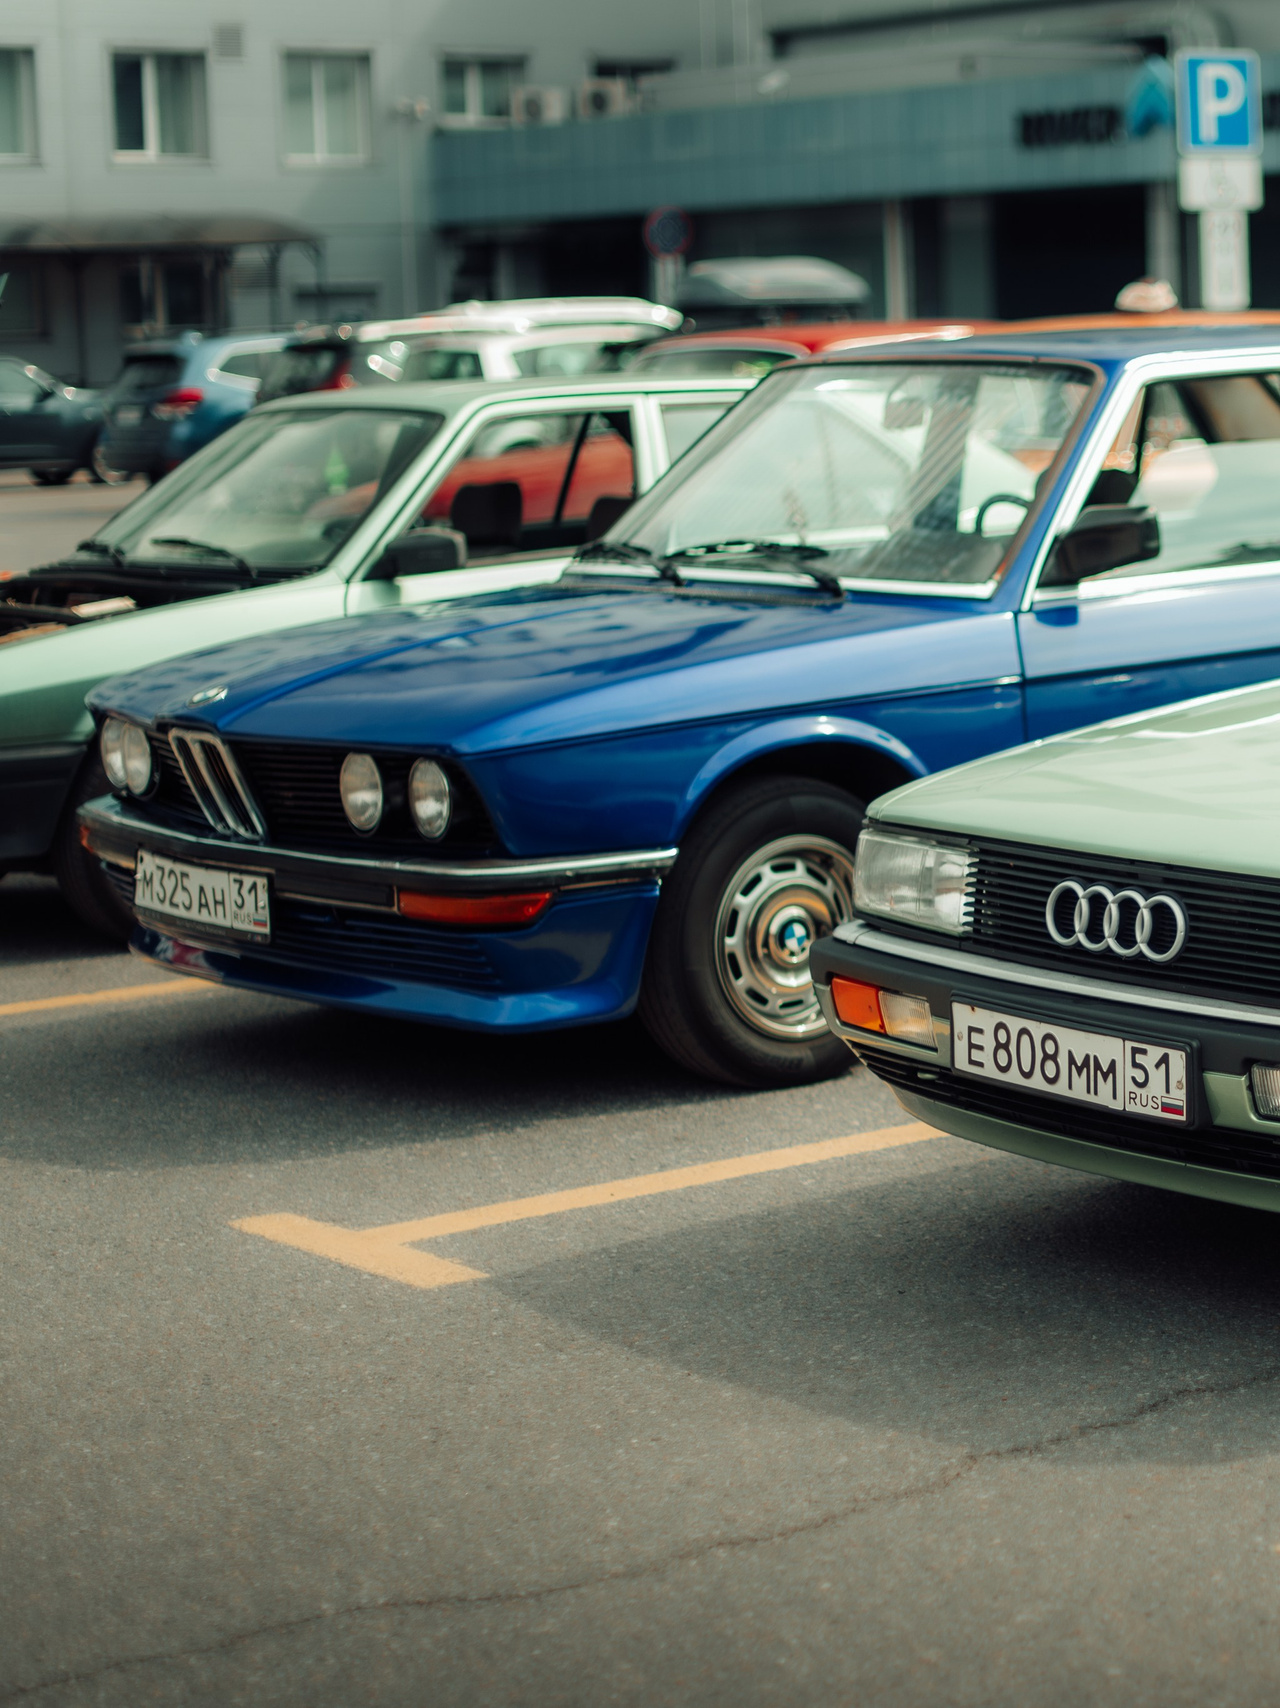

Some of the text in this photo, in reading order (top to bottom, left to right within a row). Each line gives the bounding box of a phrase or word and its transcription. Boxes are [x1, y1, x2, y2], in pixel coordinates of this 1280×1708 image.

[1195, 61, 1247, 144] P
[233, 911, 252, 925] RUS
[1128, 1091, 1160, 1110] RUS
